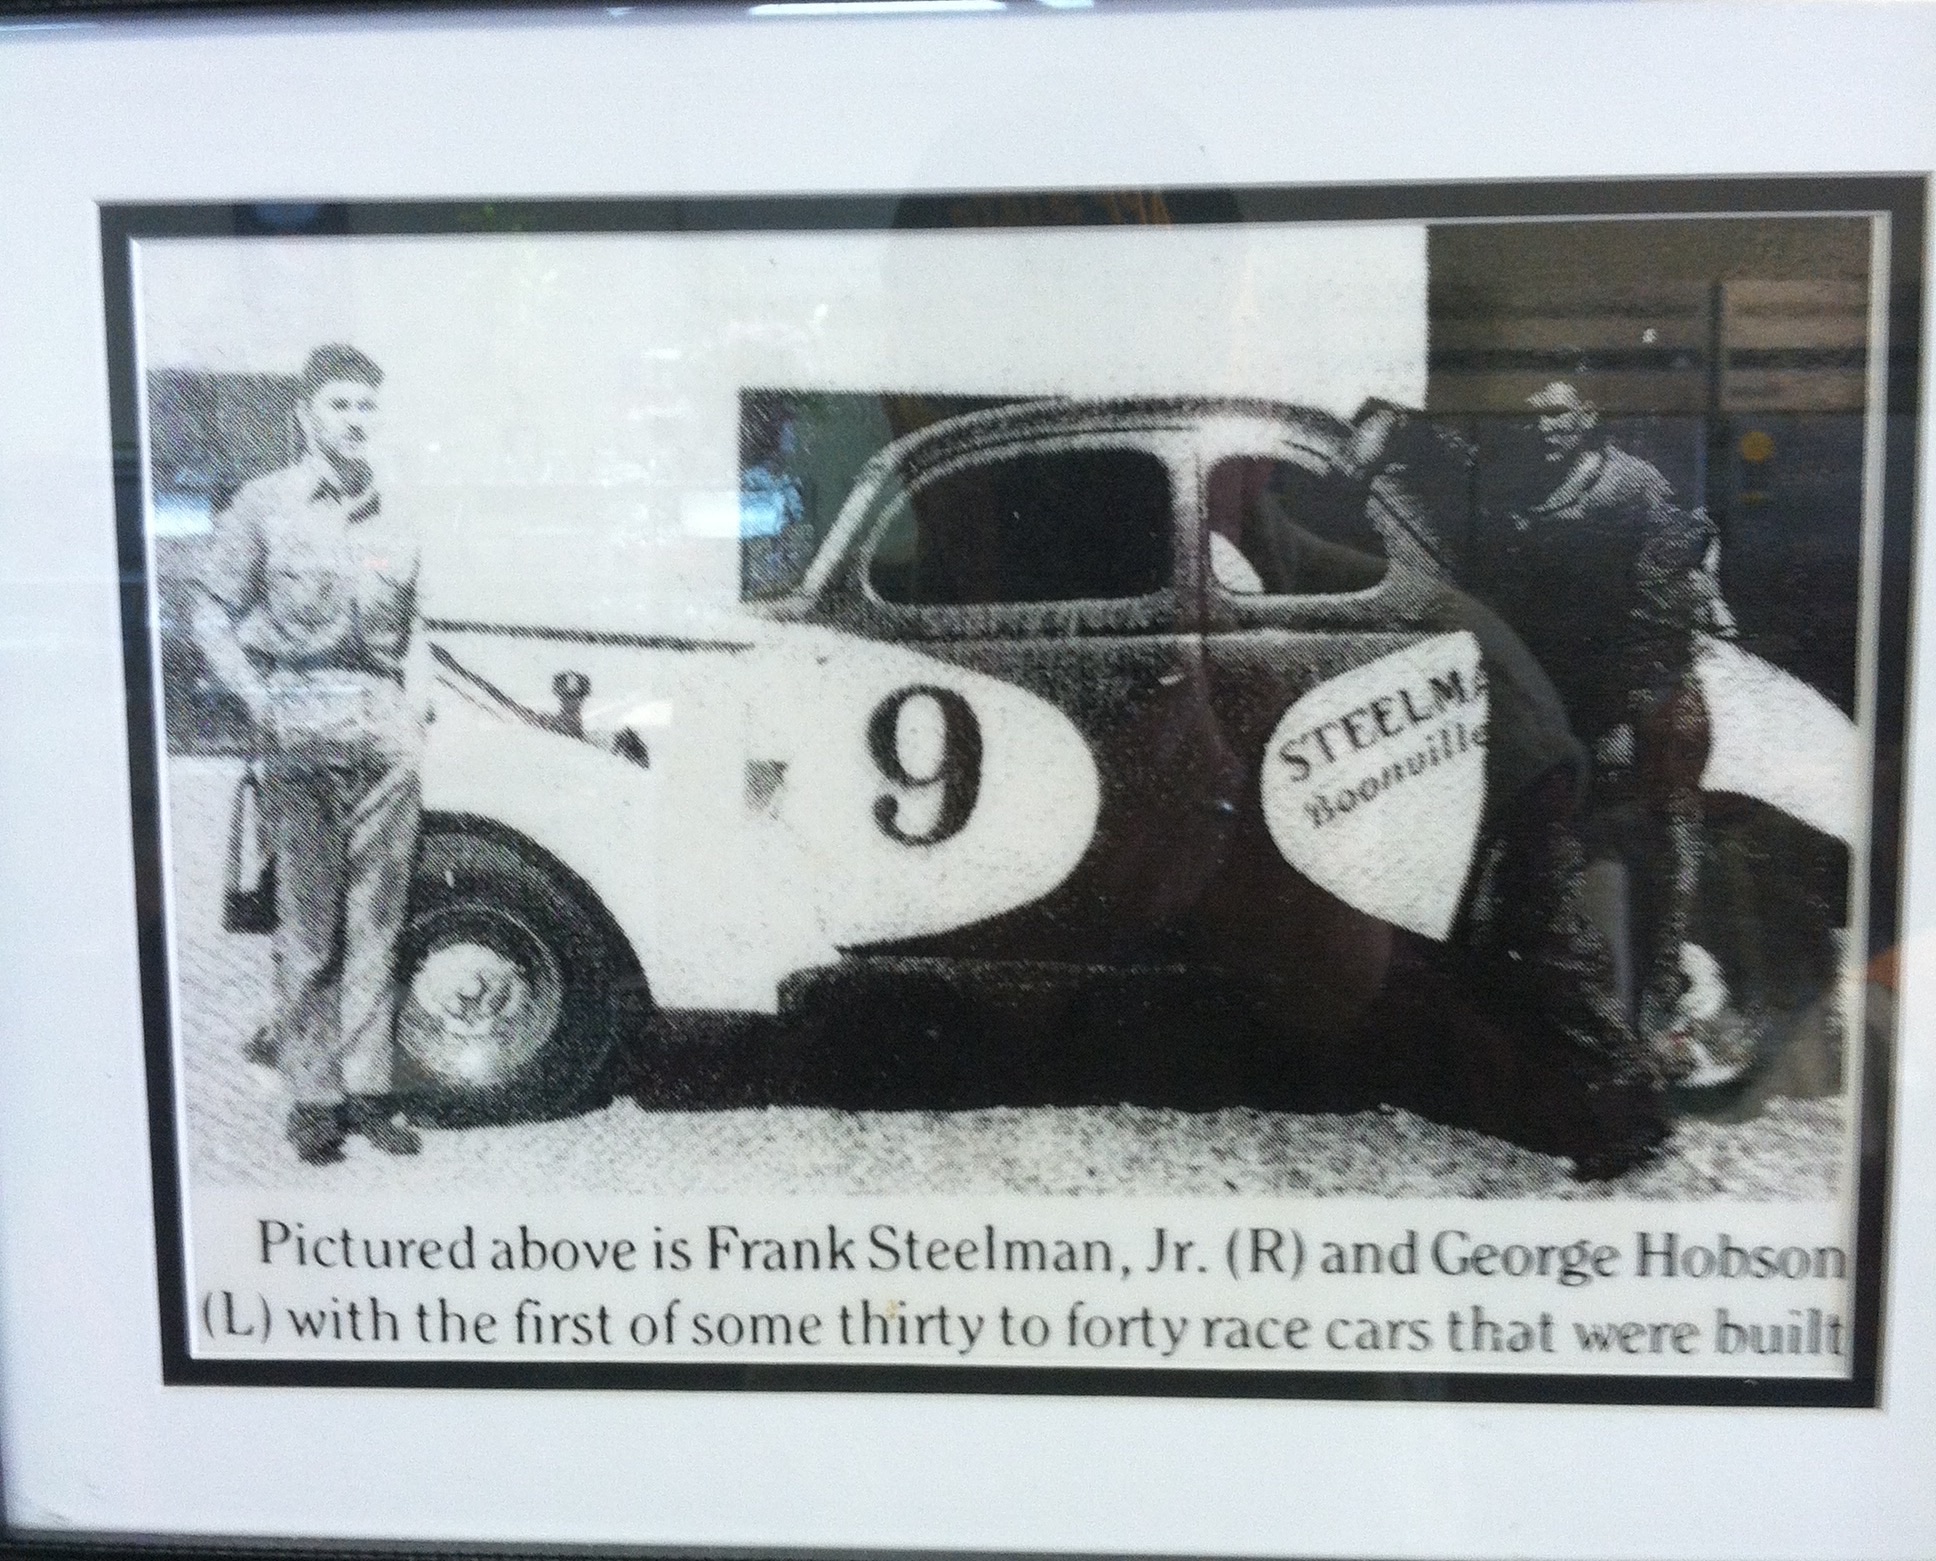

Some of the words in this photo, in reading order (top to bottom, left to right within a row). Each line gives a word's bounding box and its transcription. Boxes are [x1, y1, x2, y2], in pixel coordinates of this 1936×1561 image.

[865, 684, 984, 847] 9
[258, 1219, 476, 1270] Pictured
[491, 1224, 636, 1272] above
[654, 1226, 692, 1271] is
[708, 1224, 856, 1271] Frank
[868, 1224, 1130, 1277] Steelman,
[1147, 1227, 1206, 1273] Jr.
[1226, 1228, 1304, 1279] (R)
[1321, 1229, 1417, 1275] and
[1431, 1230, 1618, 1287] George
[1635, 1231, 1847, 1280] Hobson
[202, 1290, 272, 1339] (L)
[287, 1296, 399, 1342] with
[416, 1297, 497, 1345] the
[515, 1298, 611, 1346] first
[629, 1298, 681, 1345] of
[692, 1313, 822, 1346] some
[839, 1299, 984, 1355] thirty
[1000, 1306, 1050, 1346] to
[1068, 1300, 1188, 1357] forty
[1203, 1317, 1310, 1350] race
[1326, 1319, 1430, 1351] cars
[1448, 1305, 1558, 1353] that
[1574, 1321, 1698, 1355] were
[1715, 1308, 1846, 1358] built
